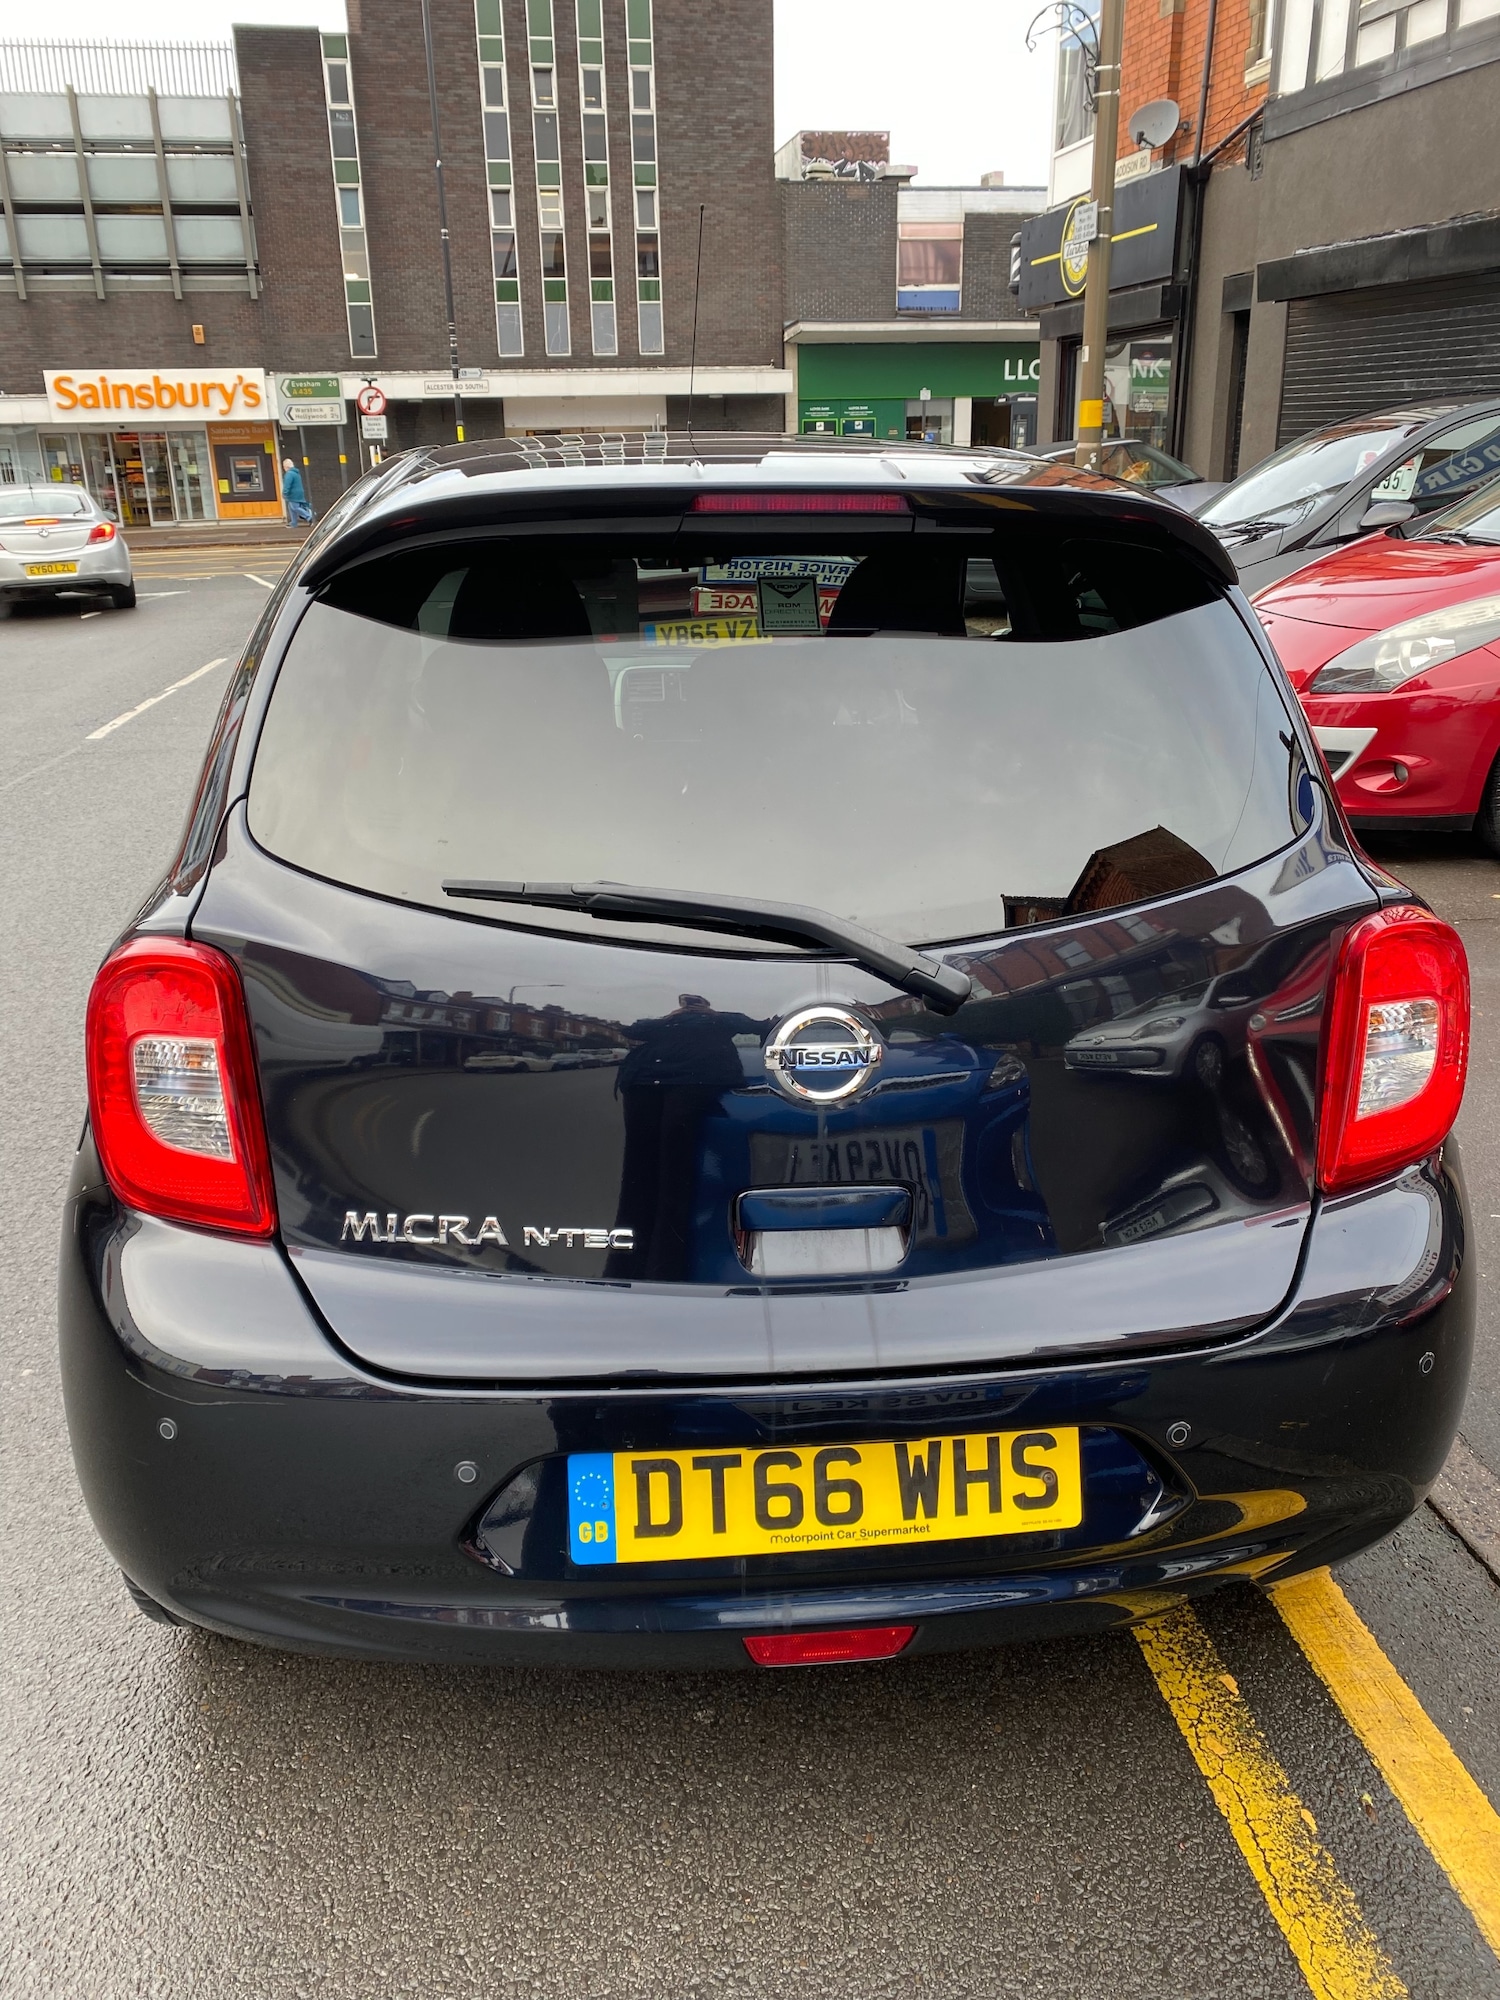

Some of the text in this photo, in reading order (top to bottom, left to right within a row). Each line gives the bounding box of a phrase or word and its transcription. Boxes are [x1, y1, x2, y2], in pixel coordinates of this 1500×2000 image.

[1140, 155, 1148, 168] RD
[1066, 243, 1088, 257] Turkis
[1004, 358, 1041, 381] LLO
[291, 380, 338, 388] Evesham 26
[53, 374, 261, 416] Sainsbury's
[210, 426, 250, 436] Sainsbury's
[1378, 470, 1402, 490] 95
[30, 563, 72, 574] EY60 LZL
[659, 620, 719, 646] YB65
[778, 1050, 871, 1065] NISSAN
[338, 1210, 634, 1250] MICRA N-TEC
[630, 1432, 1060, 1540] DT66 WHS
[578, 1520, 609, 1544] GB
[836, 1528, 857, 1540] Car
[858, 1523, 931, 1541] Supermarket
